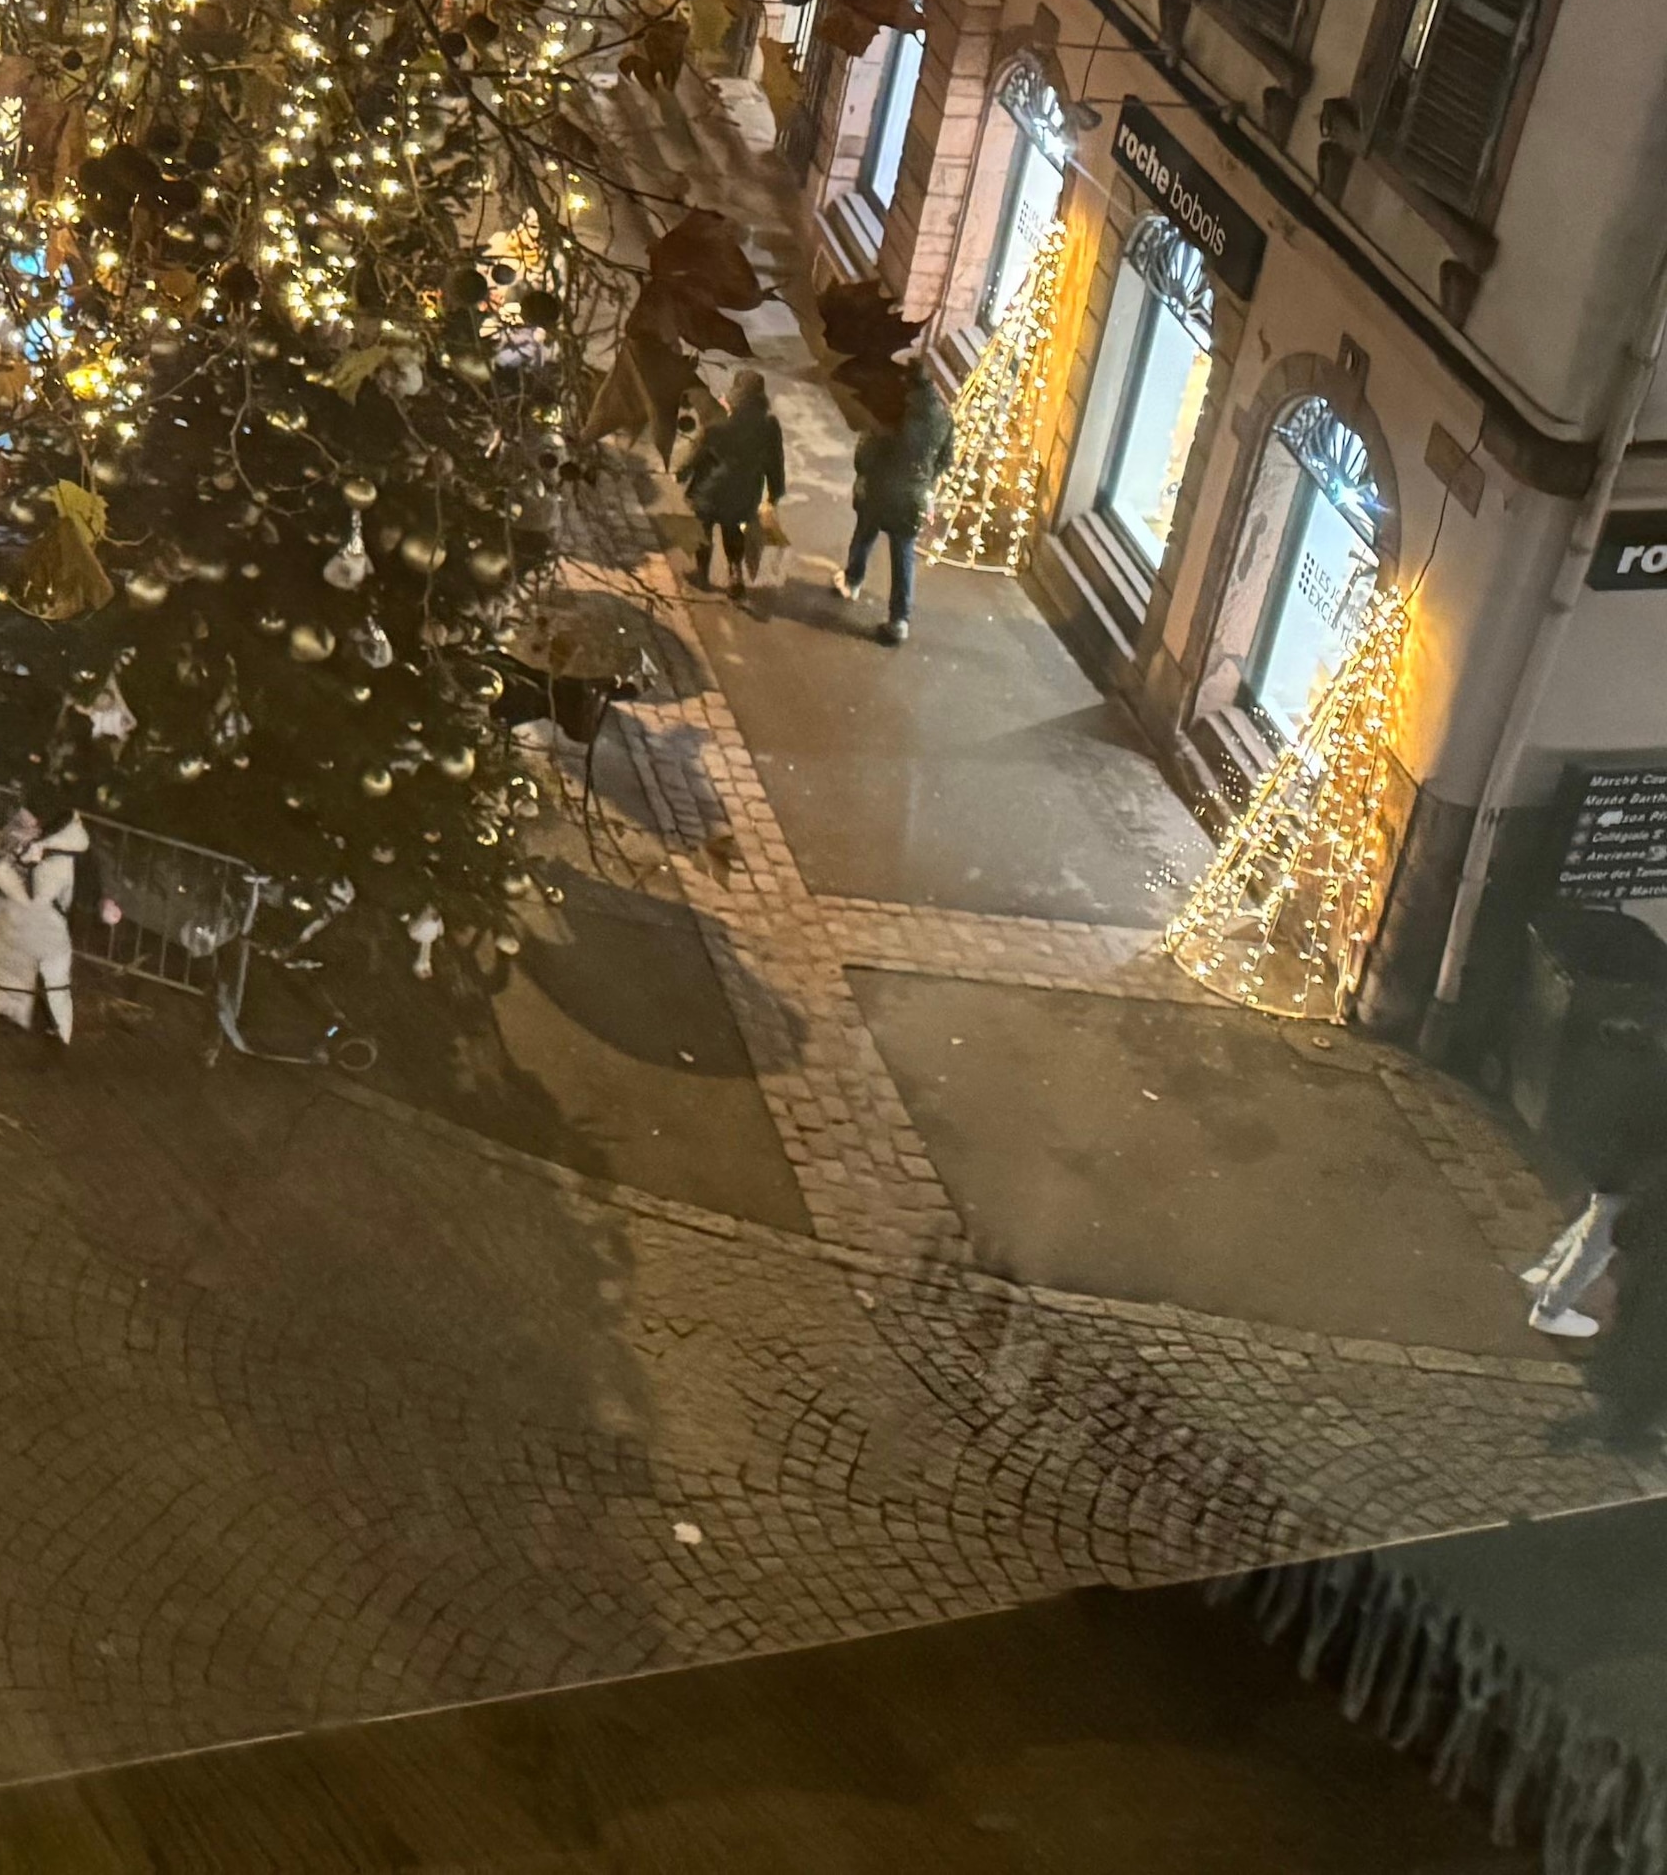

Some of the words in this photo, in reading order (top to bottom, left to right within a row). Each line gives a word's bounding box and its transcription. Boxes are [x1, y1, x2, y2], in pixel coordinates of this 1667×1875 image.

[1118, 123, 1170, 194] roche
[1170, 171, 1226, 256] bobois
[1314, 562, 1331, 594] LES
